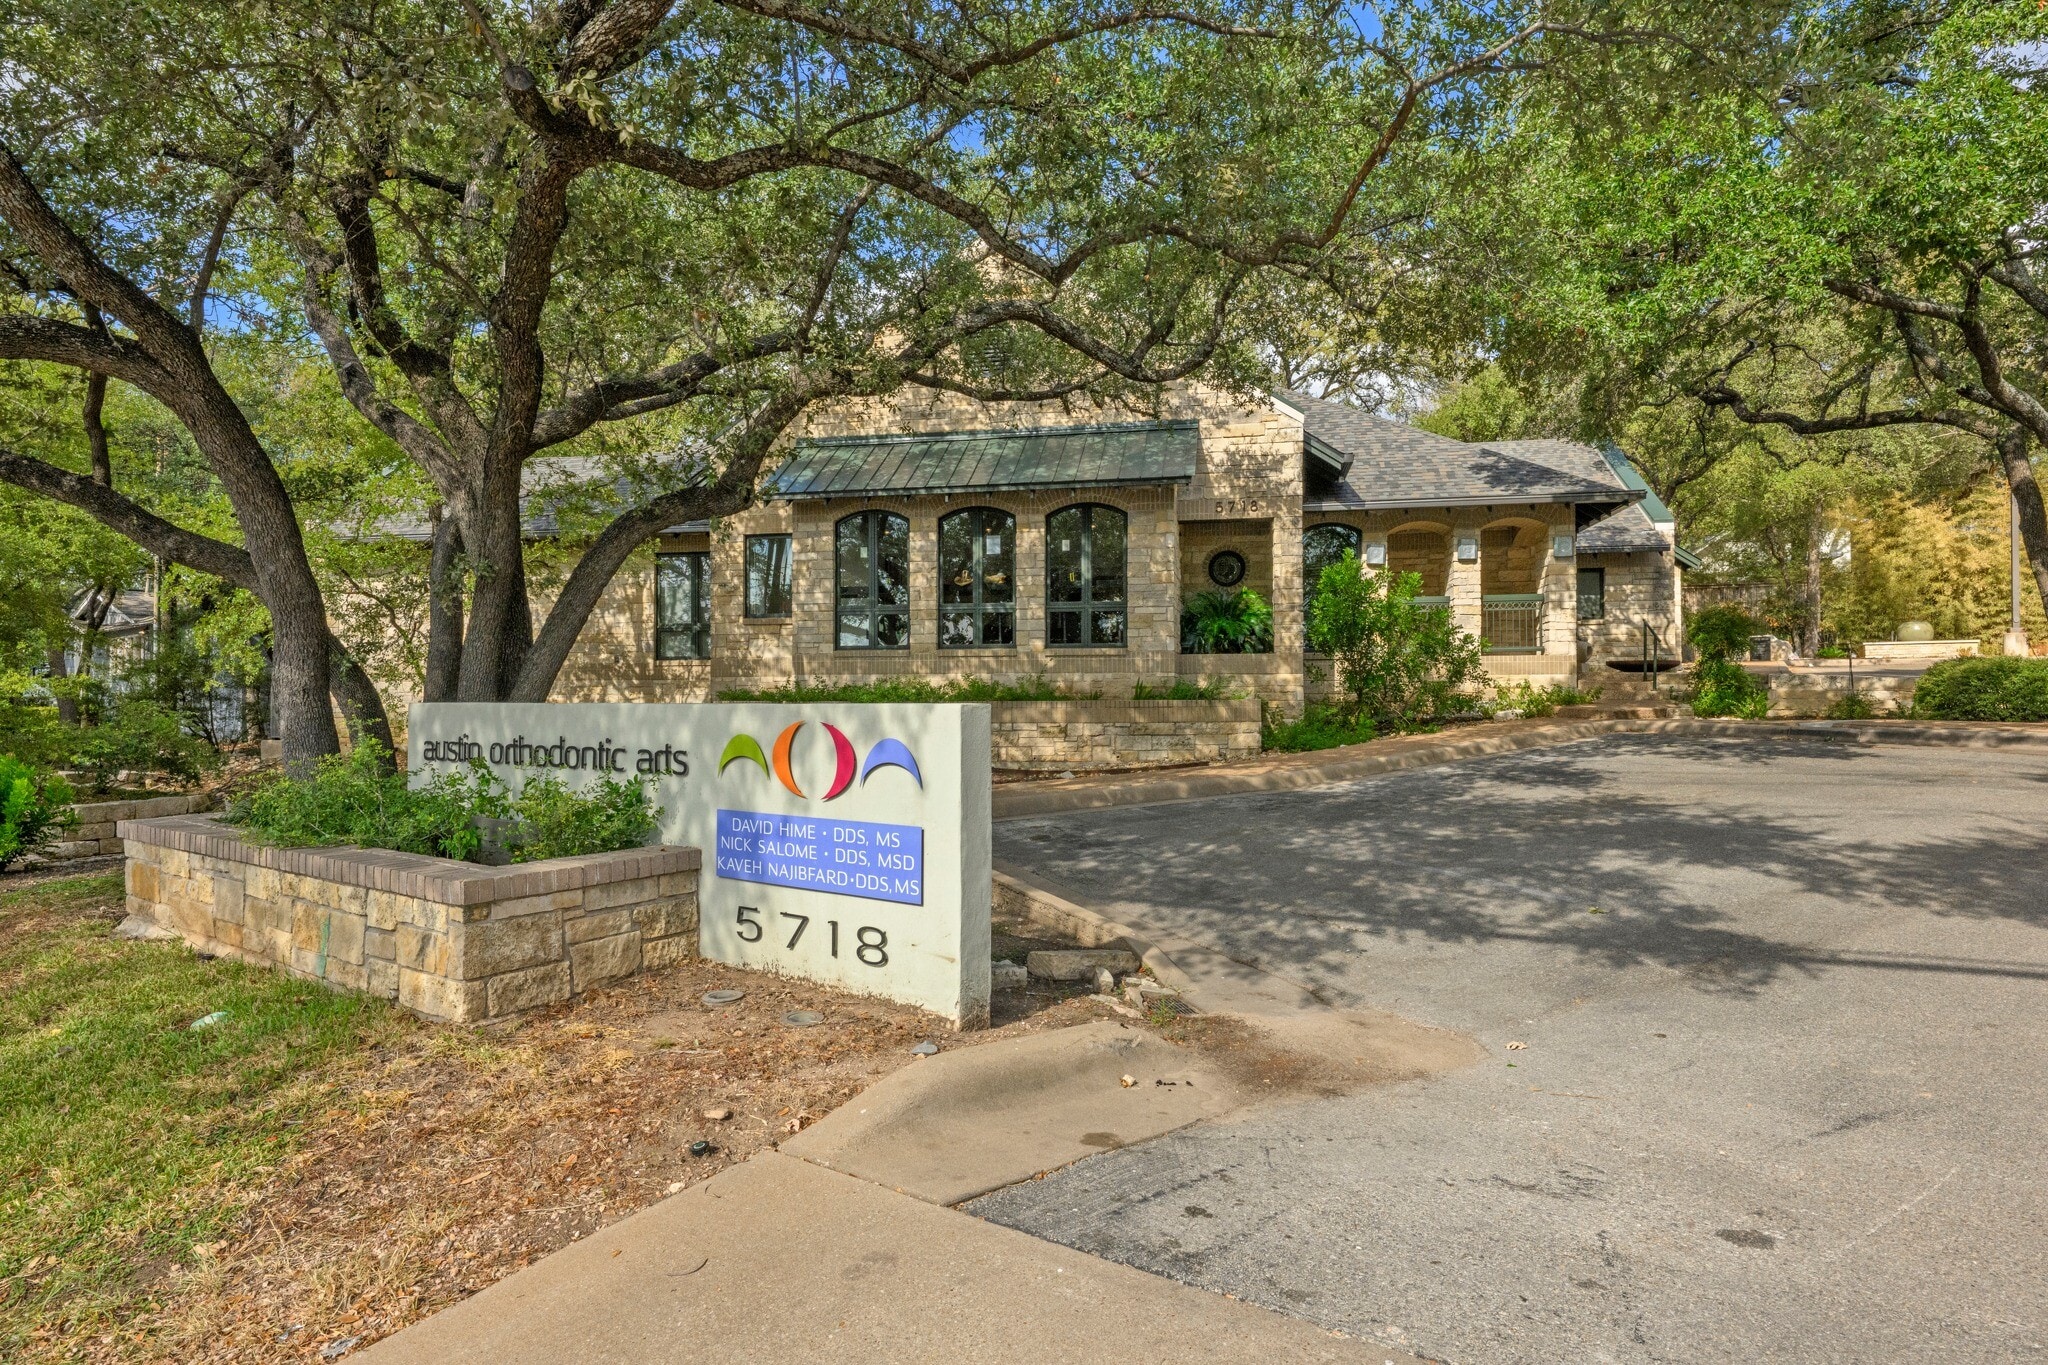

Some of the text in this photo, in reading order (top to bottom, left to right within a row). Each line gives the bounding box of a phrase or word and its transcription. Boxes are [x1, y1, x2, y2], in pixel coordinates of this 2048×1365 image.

[1215, 500, 1258, 513] 5718
[424, 734, 690, 777] austin orthodontic arts
[732, 817, 901, 848] DAVID HIME DDS, MS
[717, 856, 762, 875] KAVEH
[721, 836, 915, 871] NICK SALOME DDS, MSD
[737, 905, 889, 968] 5718
